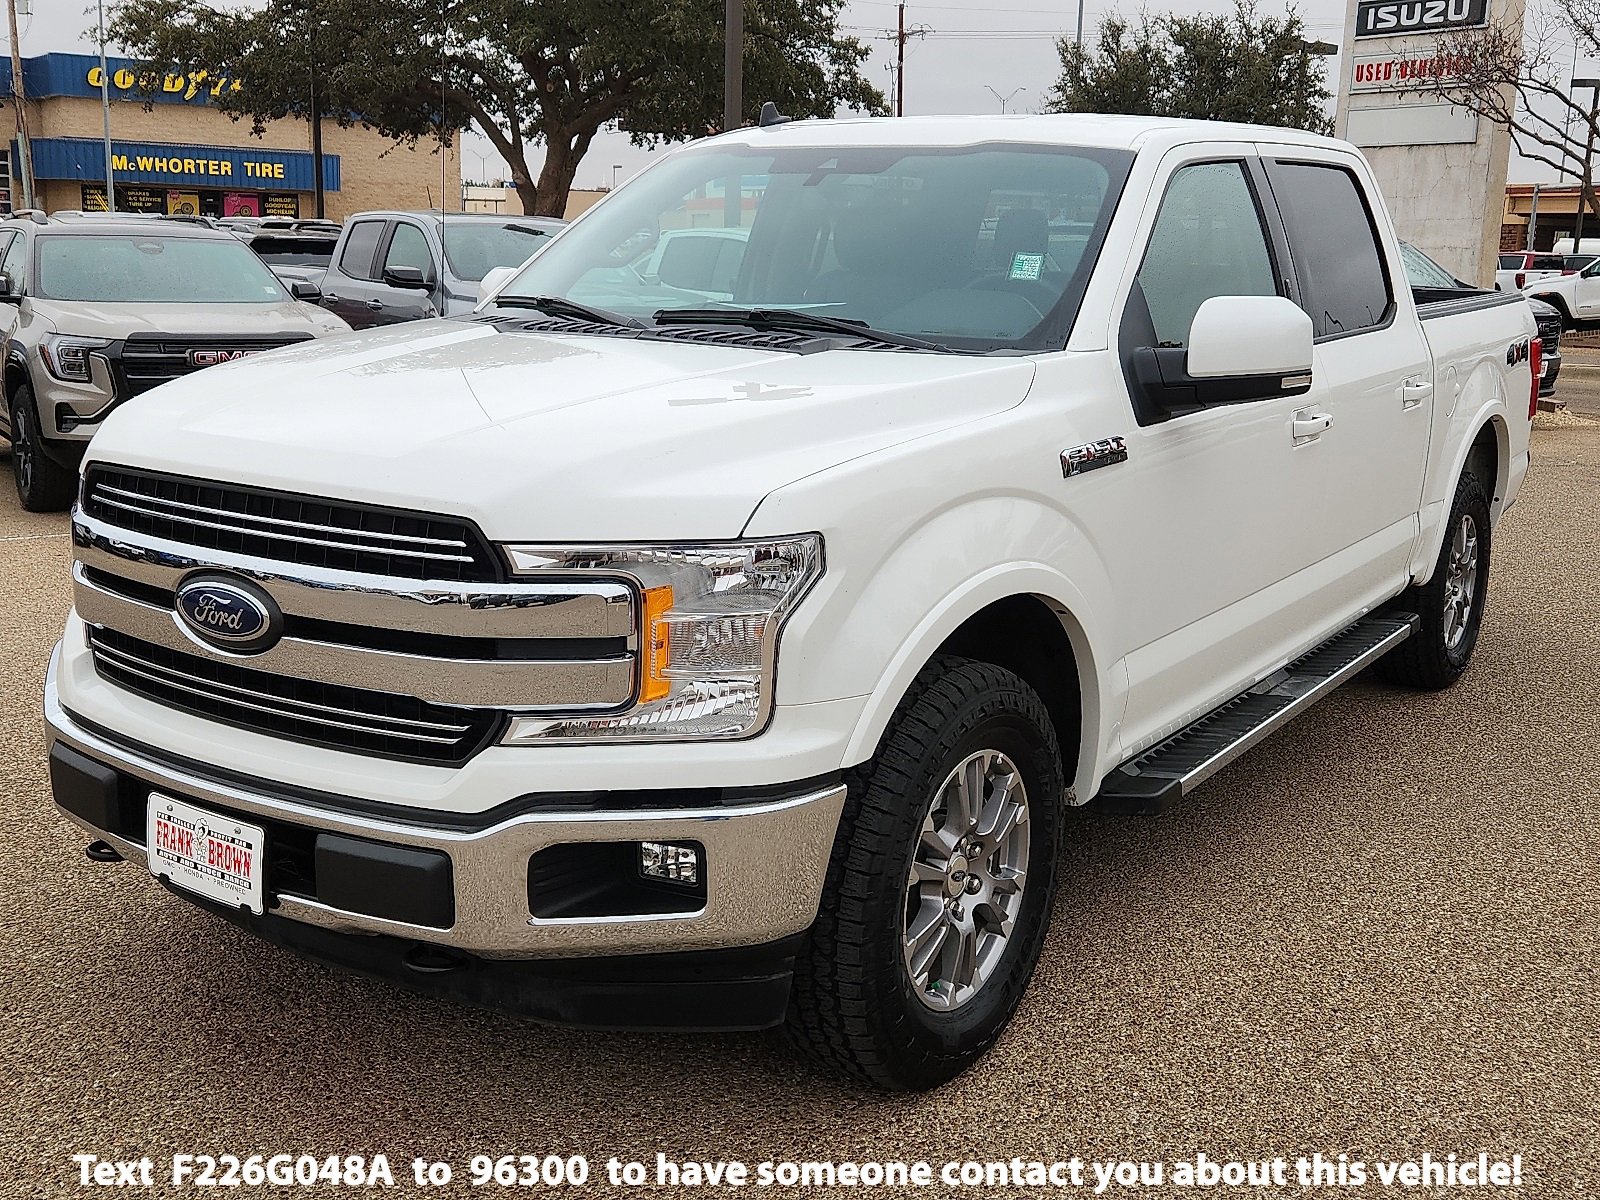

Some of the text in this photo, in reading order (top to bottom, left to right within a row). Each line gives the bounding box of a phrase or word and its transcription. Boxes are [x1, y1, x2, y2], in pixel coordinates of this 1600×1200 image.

[1367, 0, 1470, 30] ISUZU
[1356, 62, 1393, 82] USED
[112, 155, 285, 178] McWHORTER TIRE
[194, 593, 244, 630] Ford
[156, 820, 252, 878] FRANK BROWN
[158, 850, 178, 863] AUTO
[180, 857, 195, 869] AND
[197, 863, 222, 878] TRUCK
[183, 866, 204, 881] HONDA
